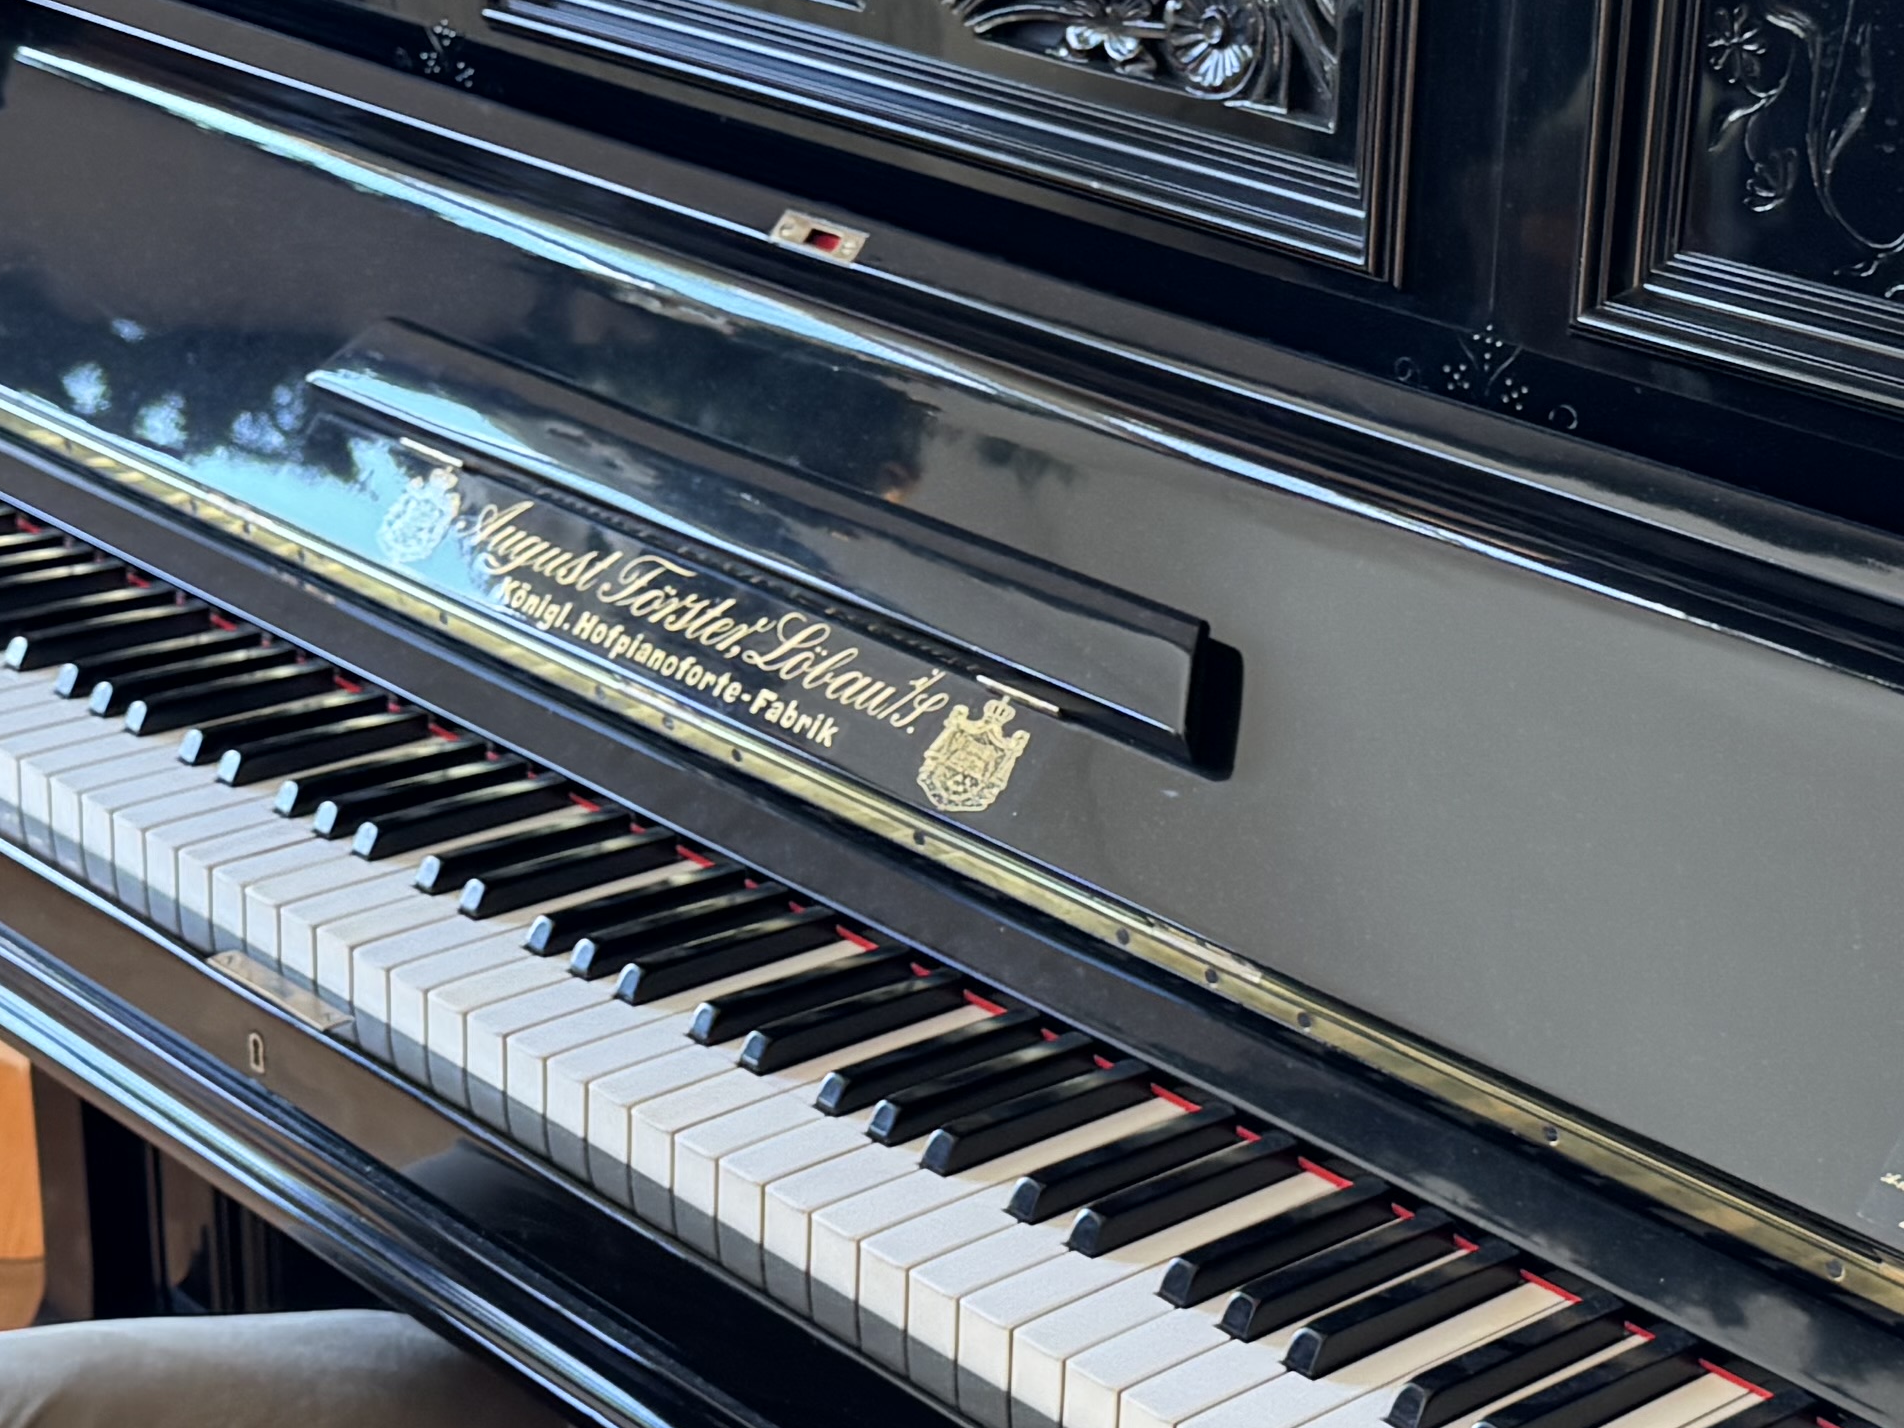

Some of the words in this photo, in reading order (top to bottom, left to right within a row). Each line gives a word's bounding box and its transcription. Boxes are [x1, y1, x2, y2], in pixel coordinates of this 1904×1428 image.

[455, 500, 623, 591] August
[596, 554, 778, 659] Förster,
[742, 611, 897, 716] Löbau
[500, 575, 573, 631] Königl.
[572, 610, 839, 748] Hofpianoforte-Fabrik
